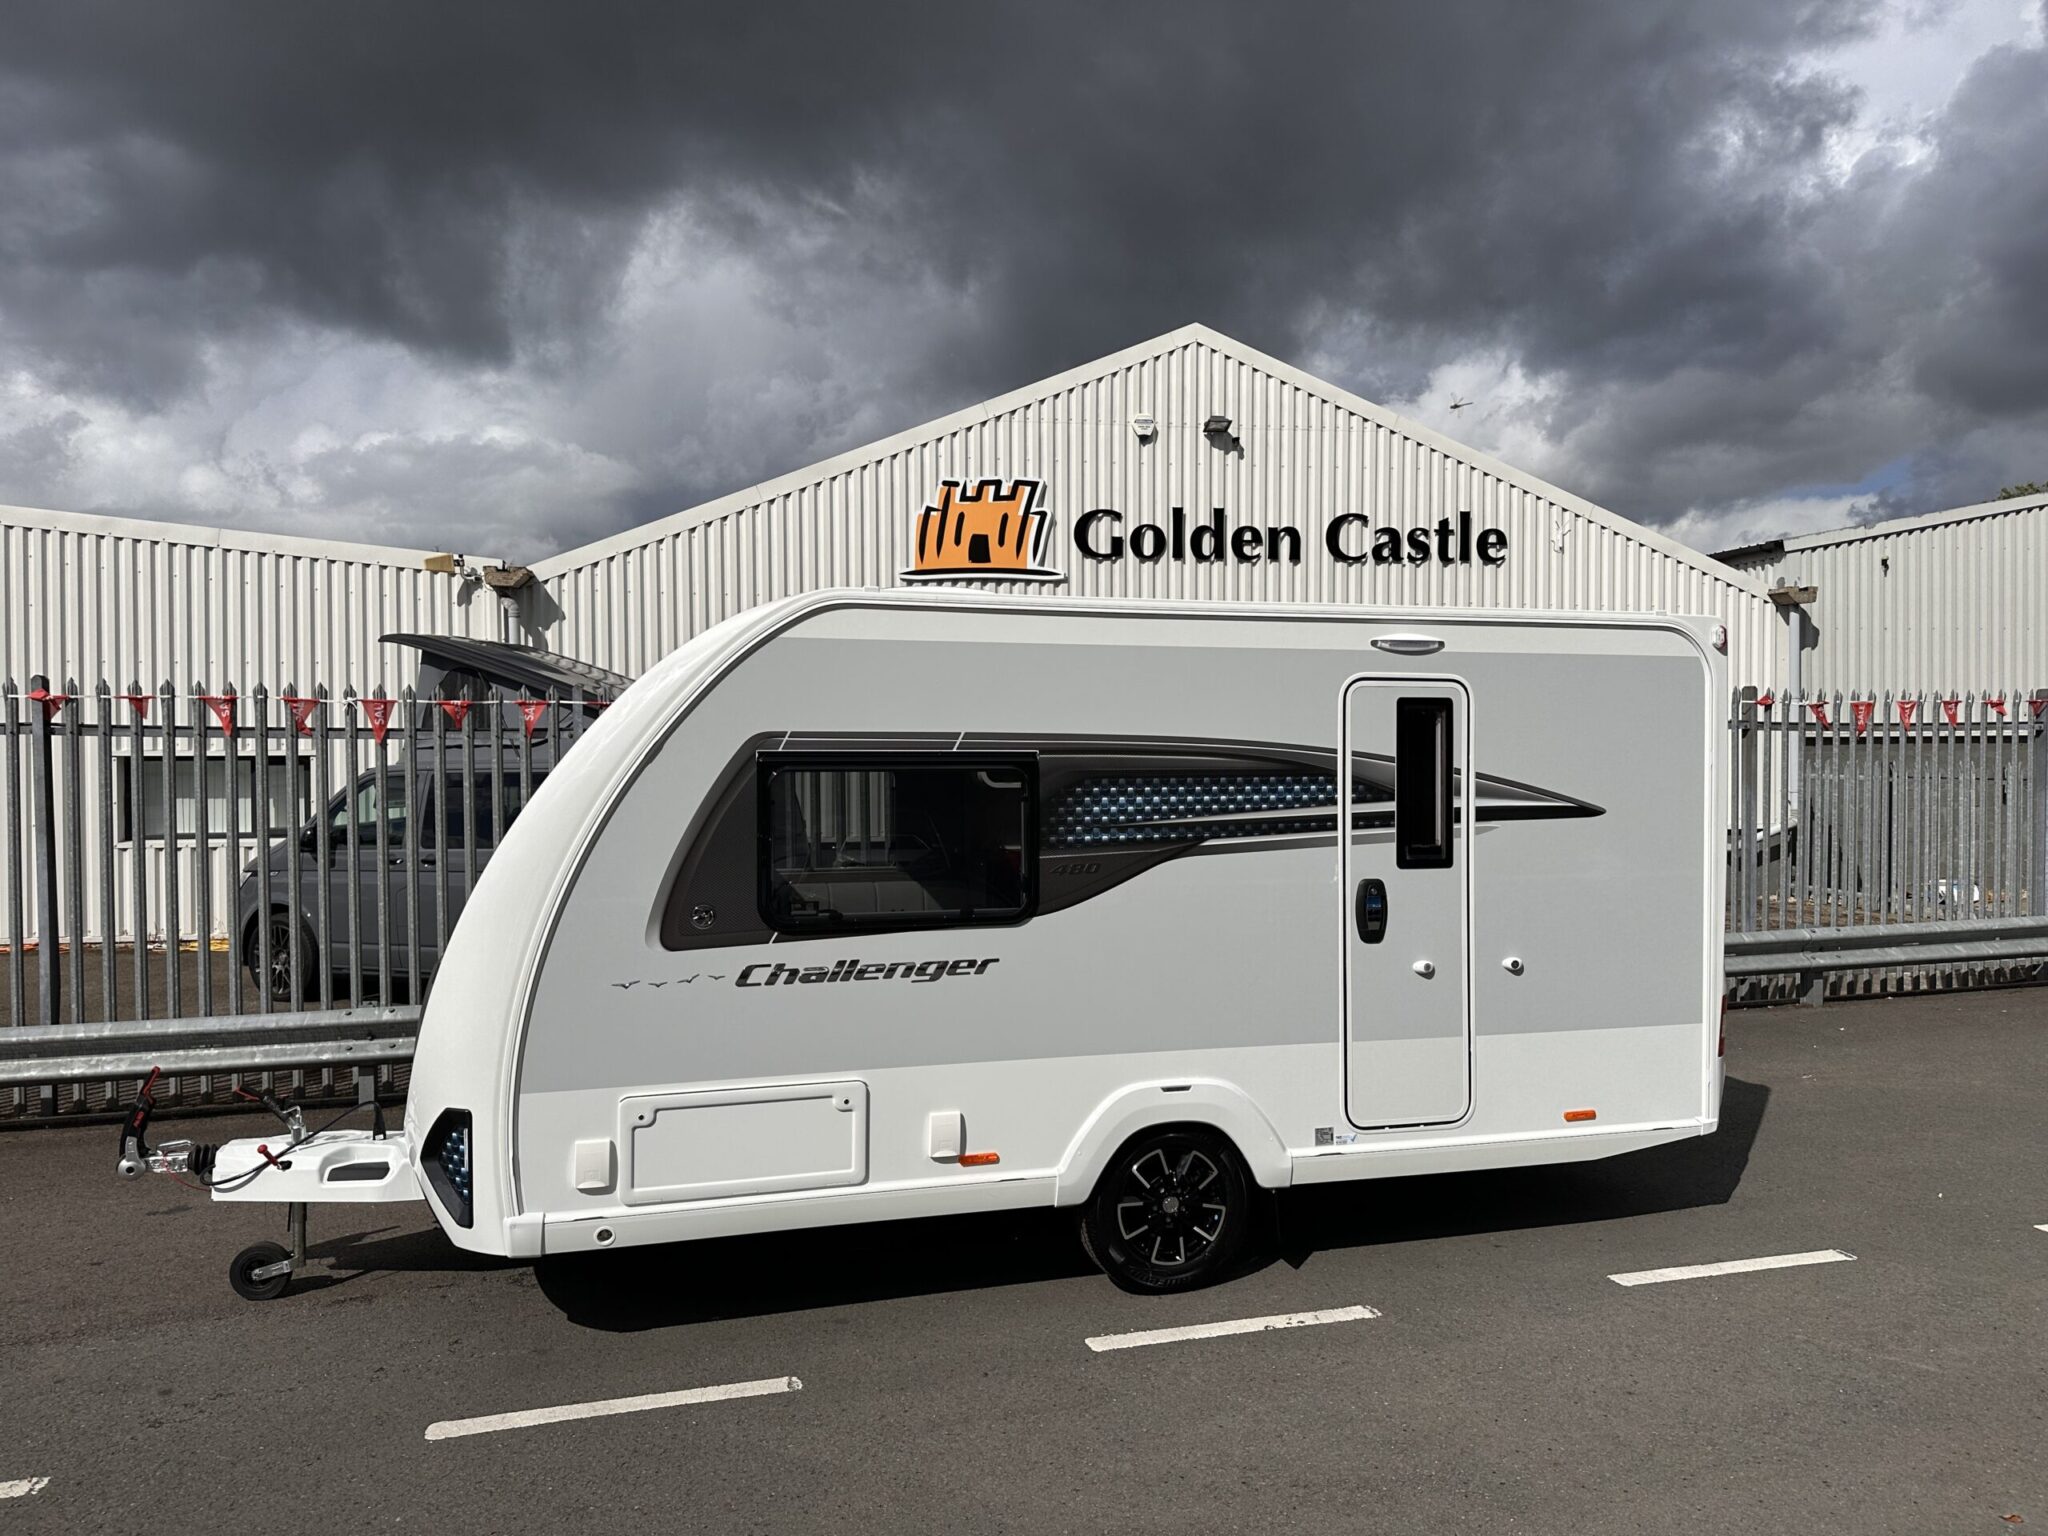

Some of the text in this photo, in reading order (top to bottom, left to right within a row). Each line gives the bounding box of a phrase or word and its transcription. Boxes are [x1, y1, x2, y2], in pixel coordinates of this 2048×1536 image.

[1074, 507, 1508, 566] Golden Castle
[1050, 862, 1102, 876] 480
[735, 958, 1000, 988] Challenger
